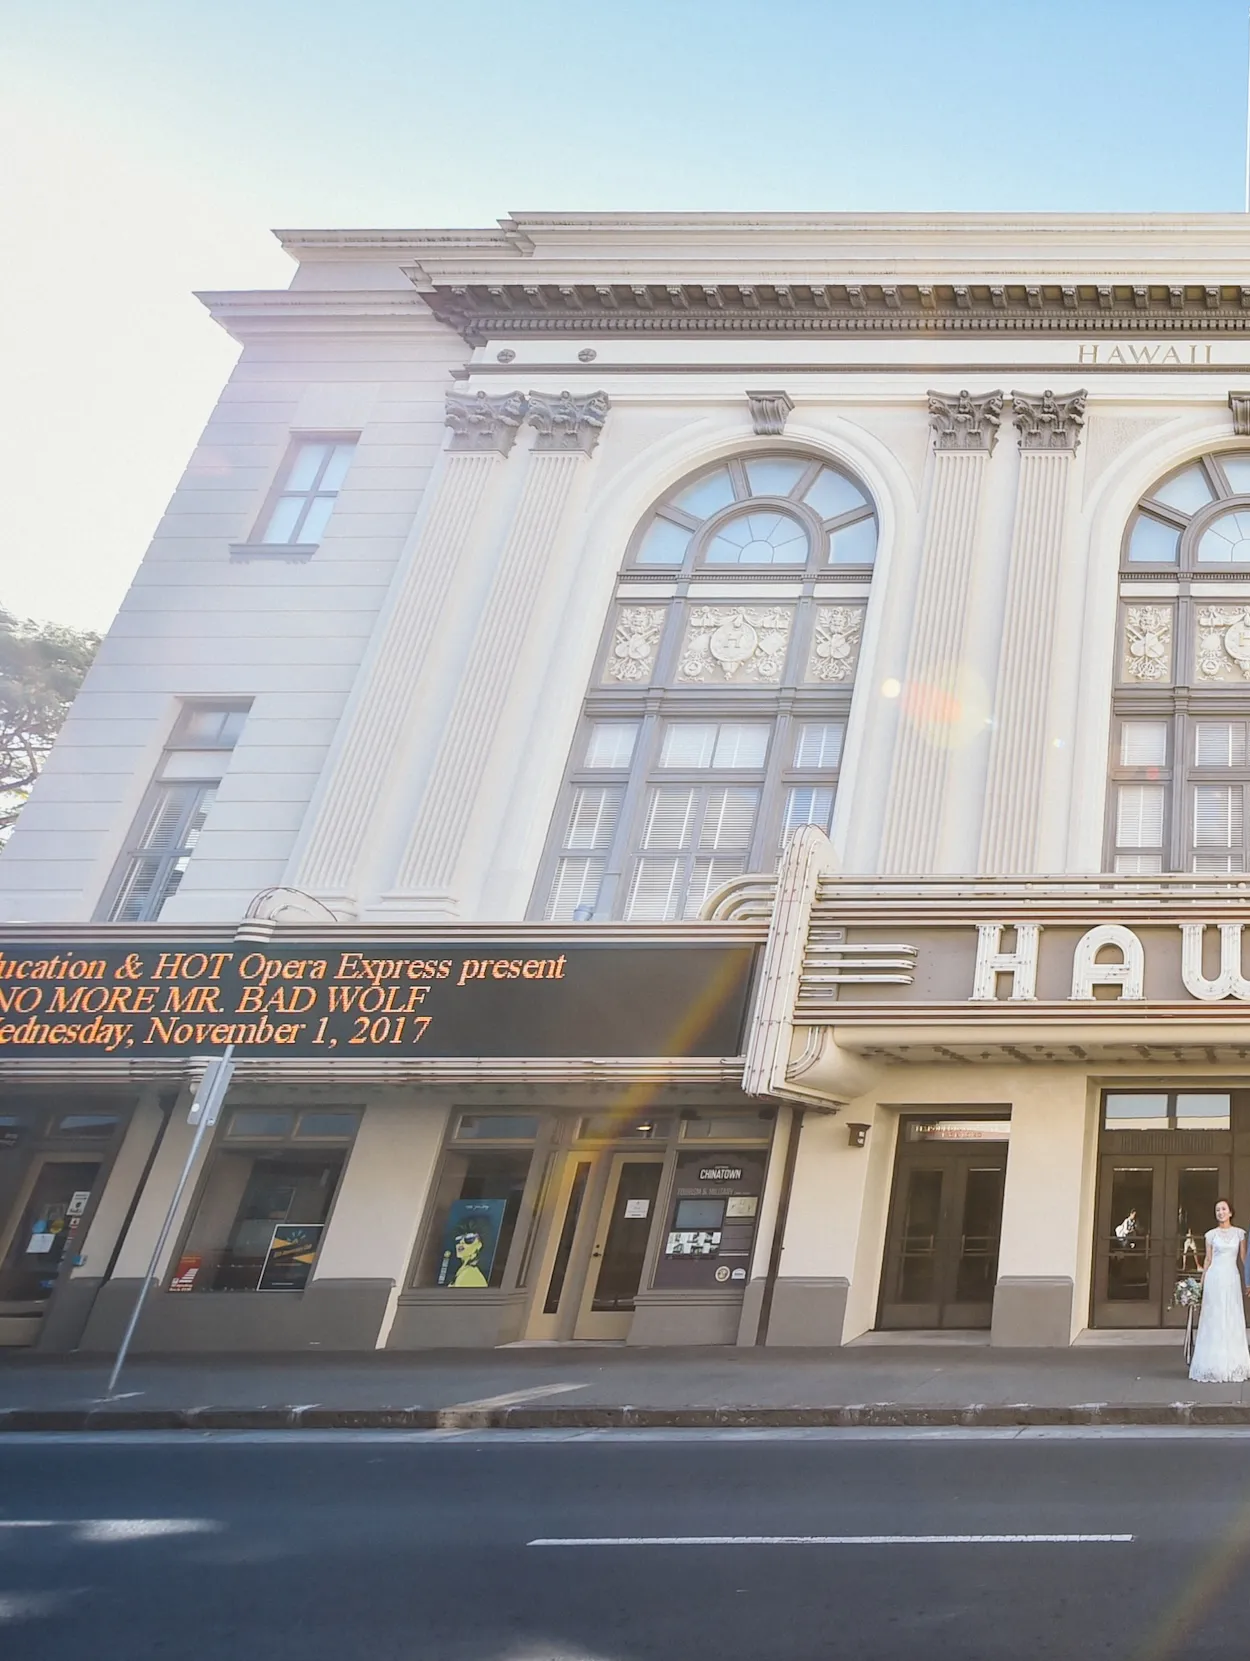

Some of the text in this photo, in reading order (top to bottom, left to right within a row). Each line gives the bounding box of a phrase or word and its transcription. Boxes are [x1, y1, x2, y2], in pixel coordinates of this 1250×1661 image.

[1078, 344, 1213, 364] HAWAII
[723, 631, 744, 649] H
[0, 952, 567, 986] ucation & HOT Opera Express present
[45, 986, 161, 1014] MORE
[160, 986, 225, 1014] MR.
[234, 986, 319, 1014] BAD
[327, 986, 431, 1013] WOLF
[0, 1015, 433, 1052] ednesday, November 1, 2017
[700, 1169, 741, 1179] CHINATOWN
